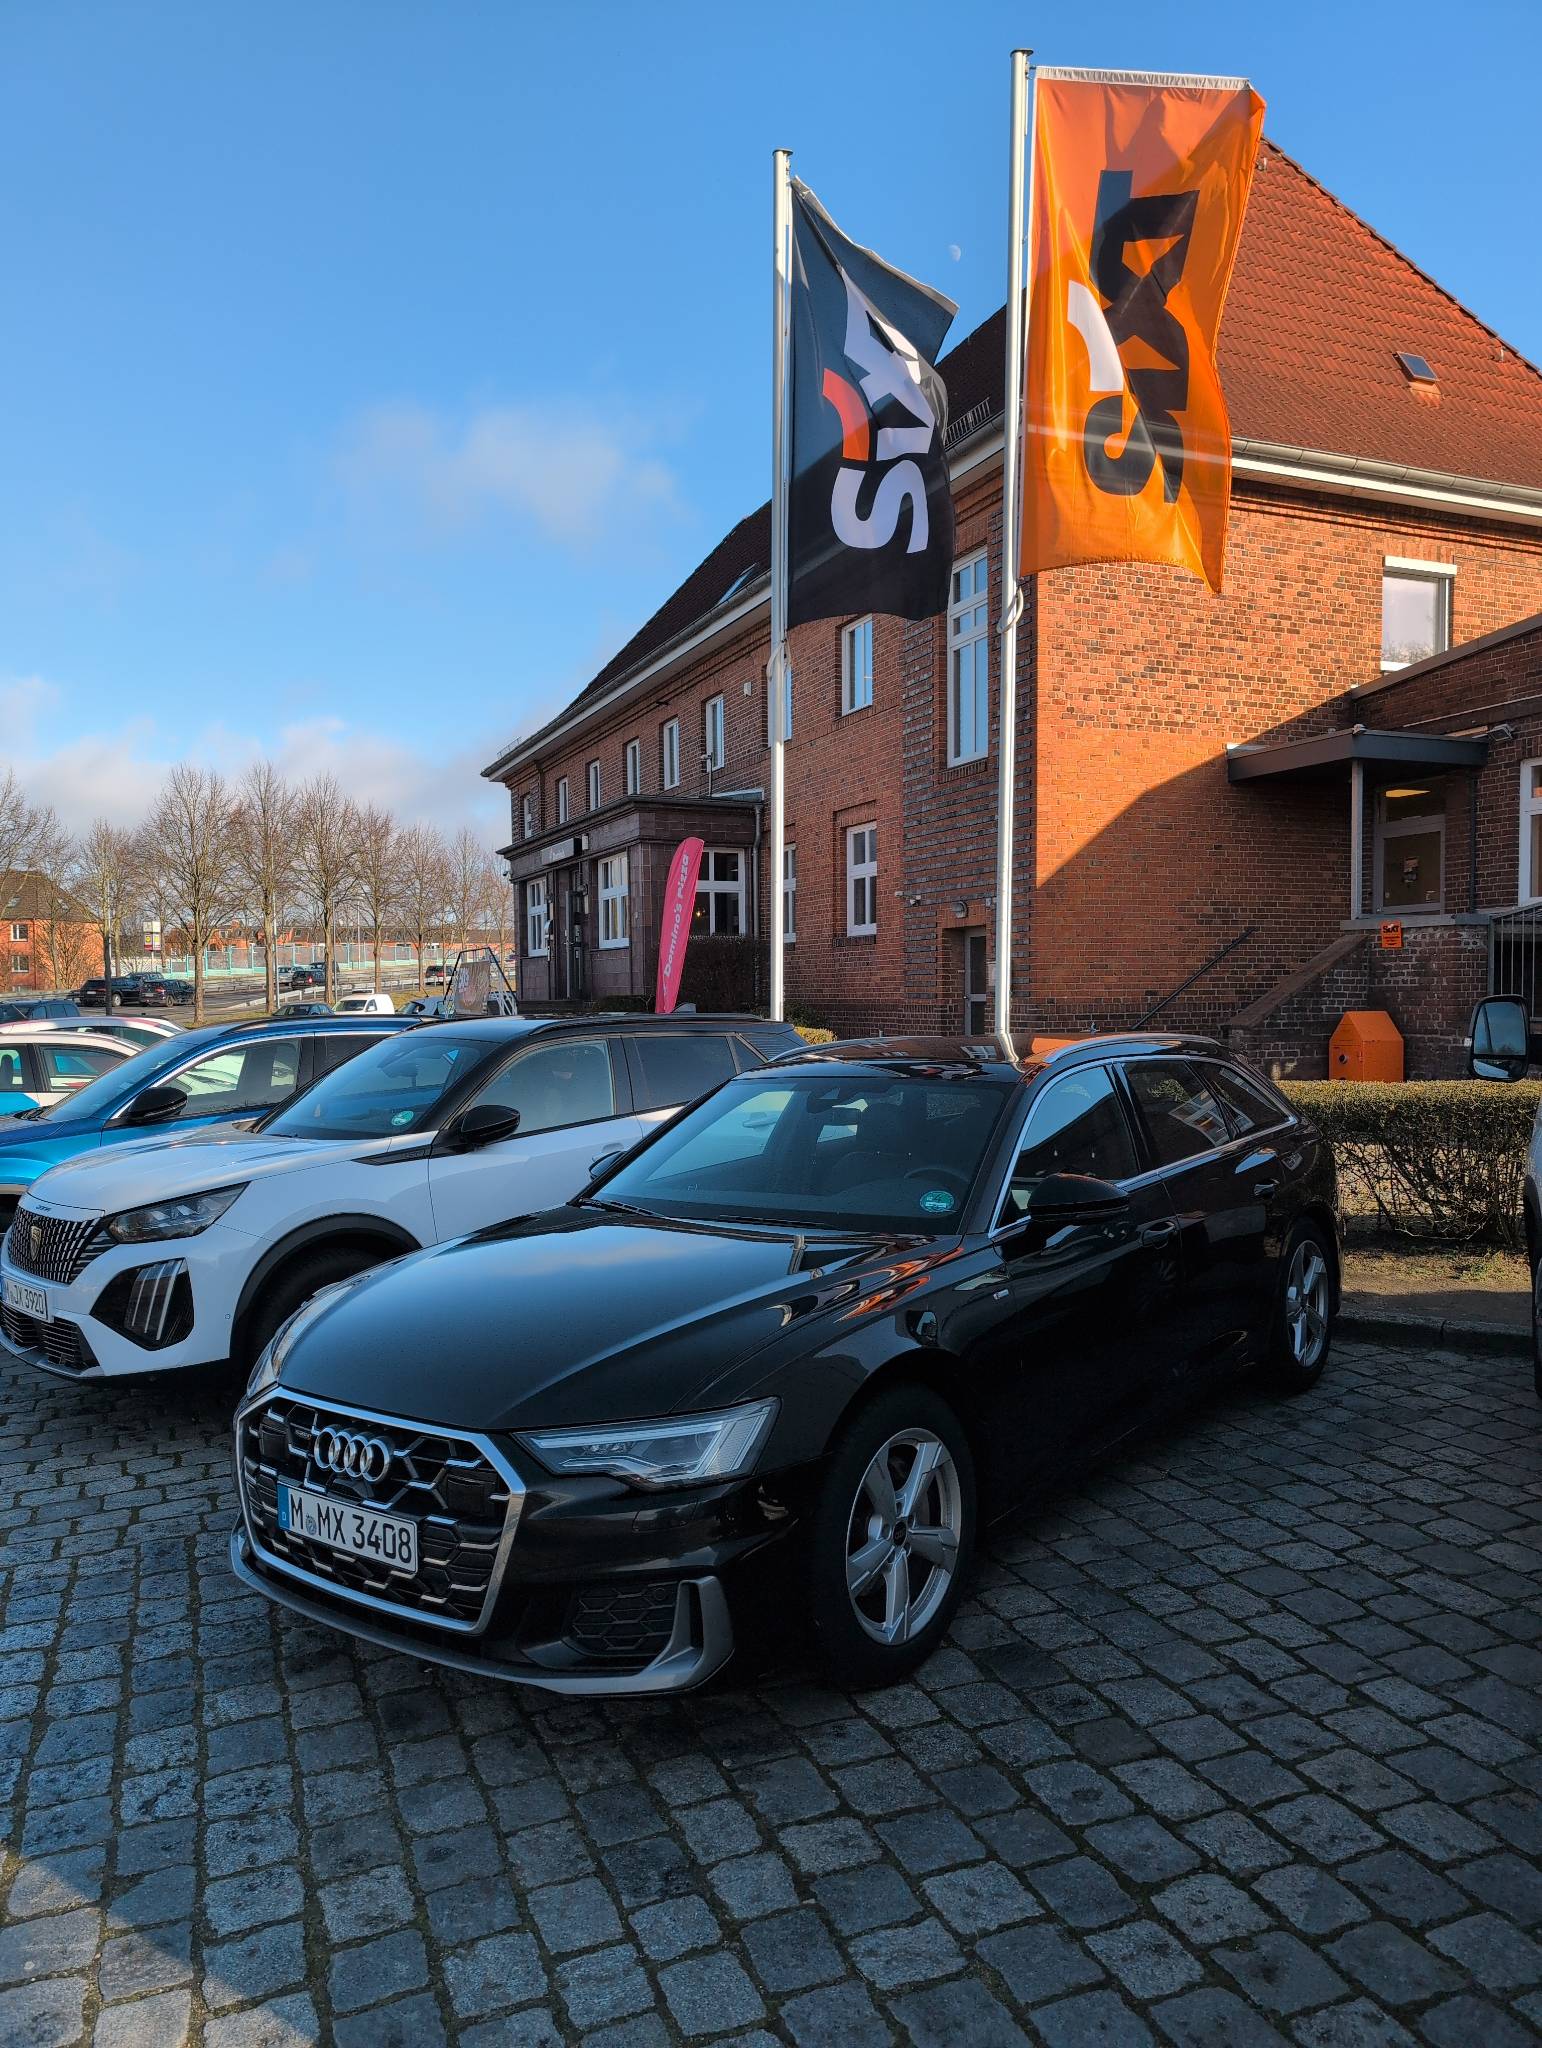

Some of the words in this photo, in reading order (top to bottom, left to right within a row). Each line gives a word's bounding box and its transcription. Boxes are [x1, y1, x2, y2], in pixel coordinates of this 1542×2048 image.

[664, 903, 683, 977] Domino's
[290, 1493, 304, 1530] M
[317, 1502, 347, 1545] MX
[352, 1513, 412, 1564] 3408
